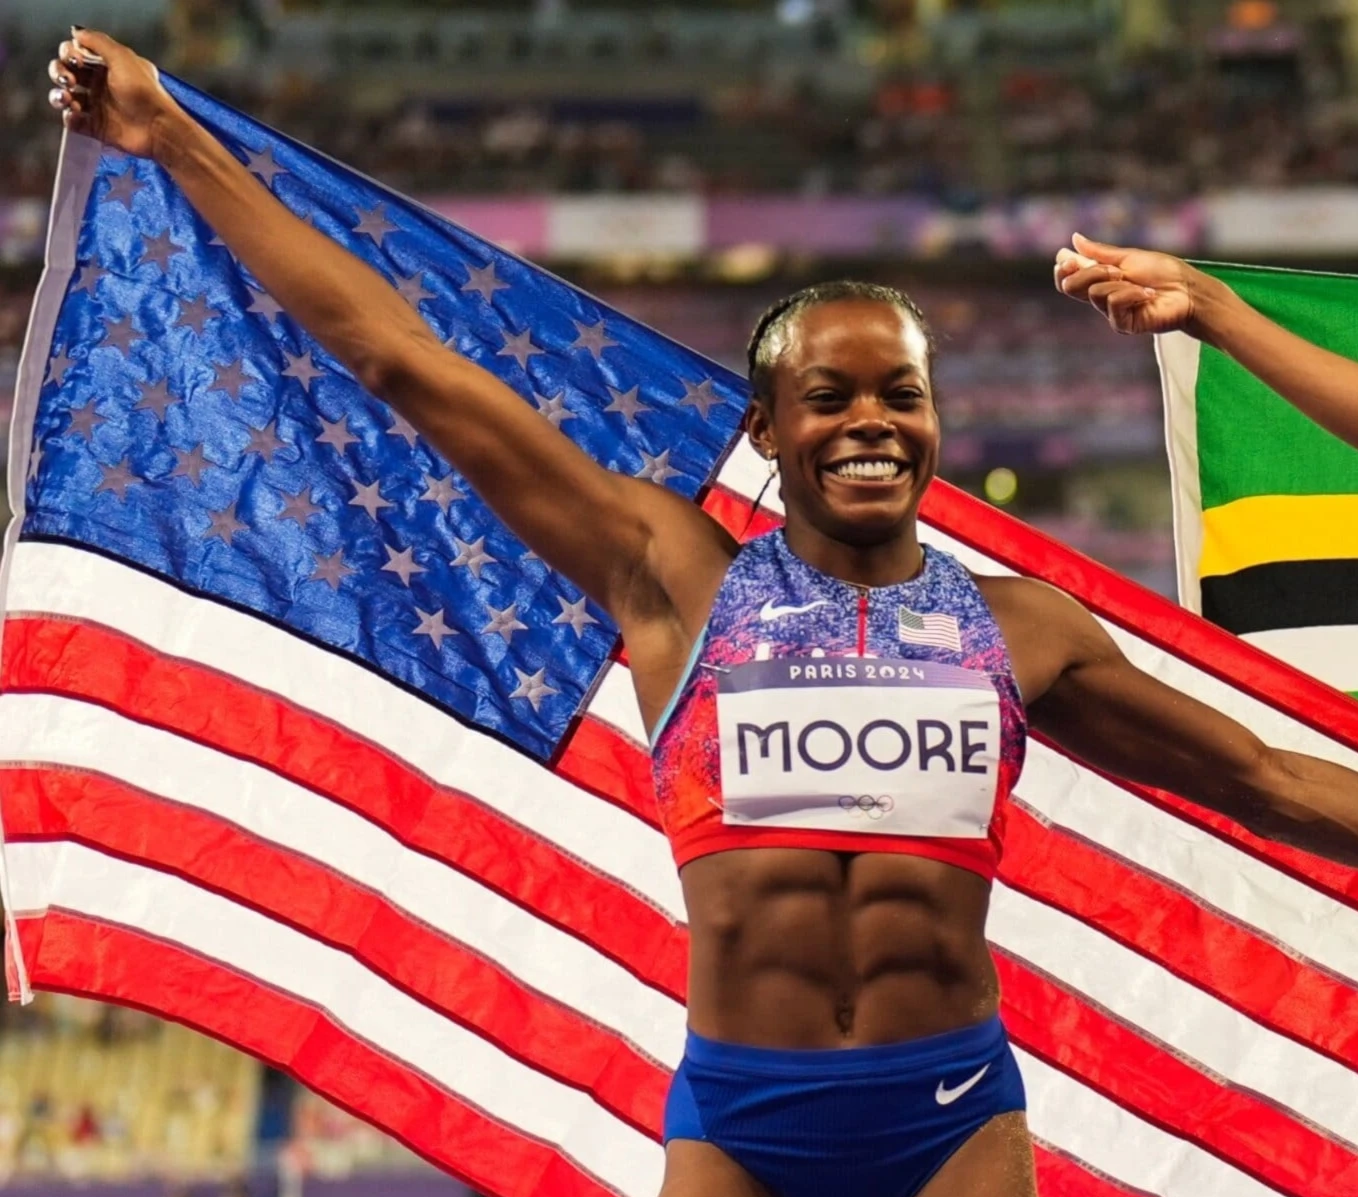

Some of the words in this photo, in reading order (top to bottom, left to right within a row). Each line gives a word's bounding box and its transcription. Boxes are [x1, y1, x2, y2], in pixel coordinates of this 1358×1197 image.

[789, 664, 858, 680] PARIS
[865, 665, 925, 680] 2024
[737, 719, 989, 775] MOORE
